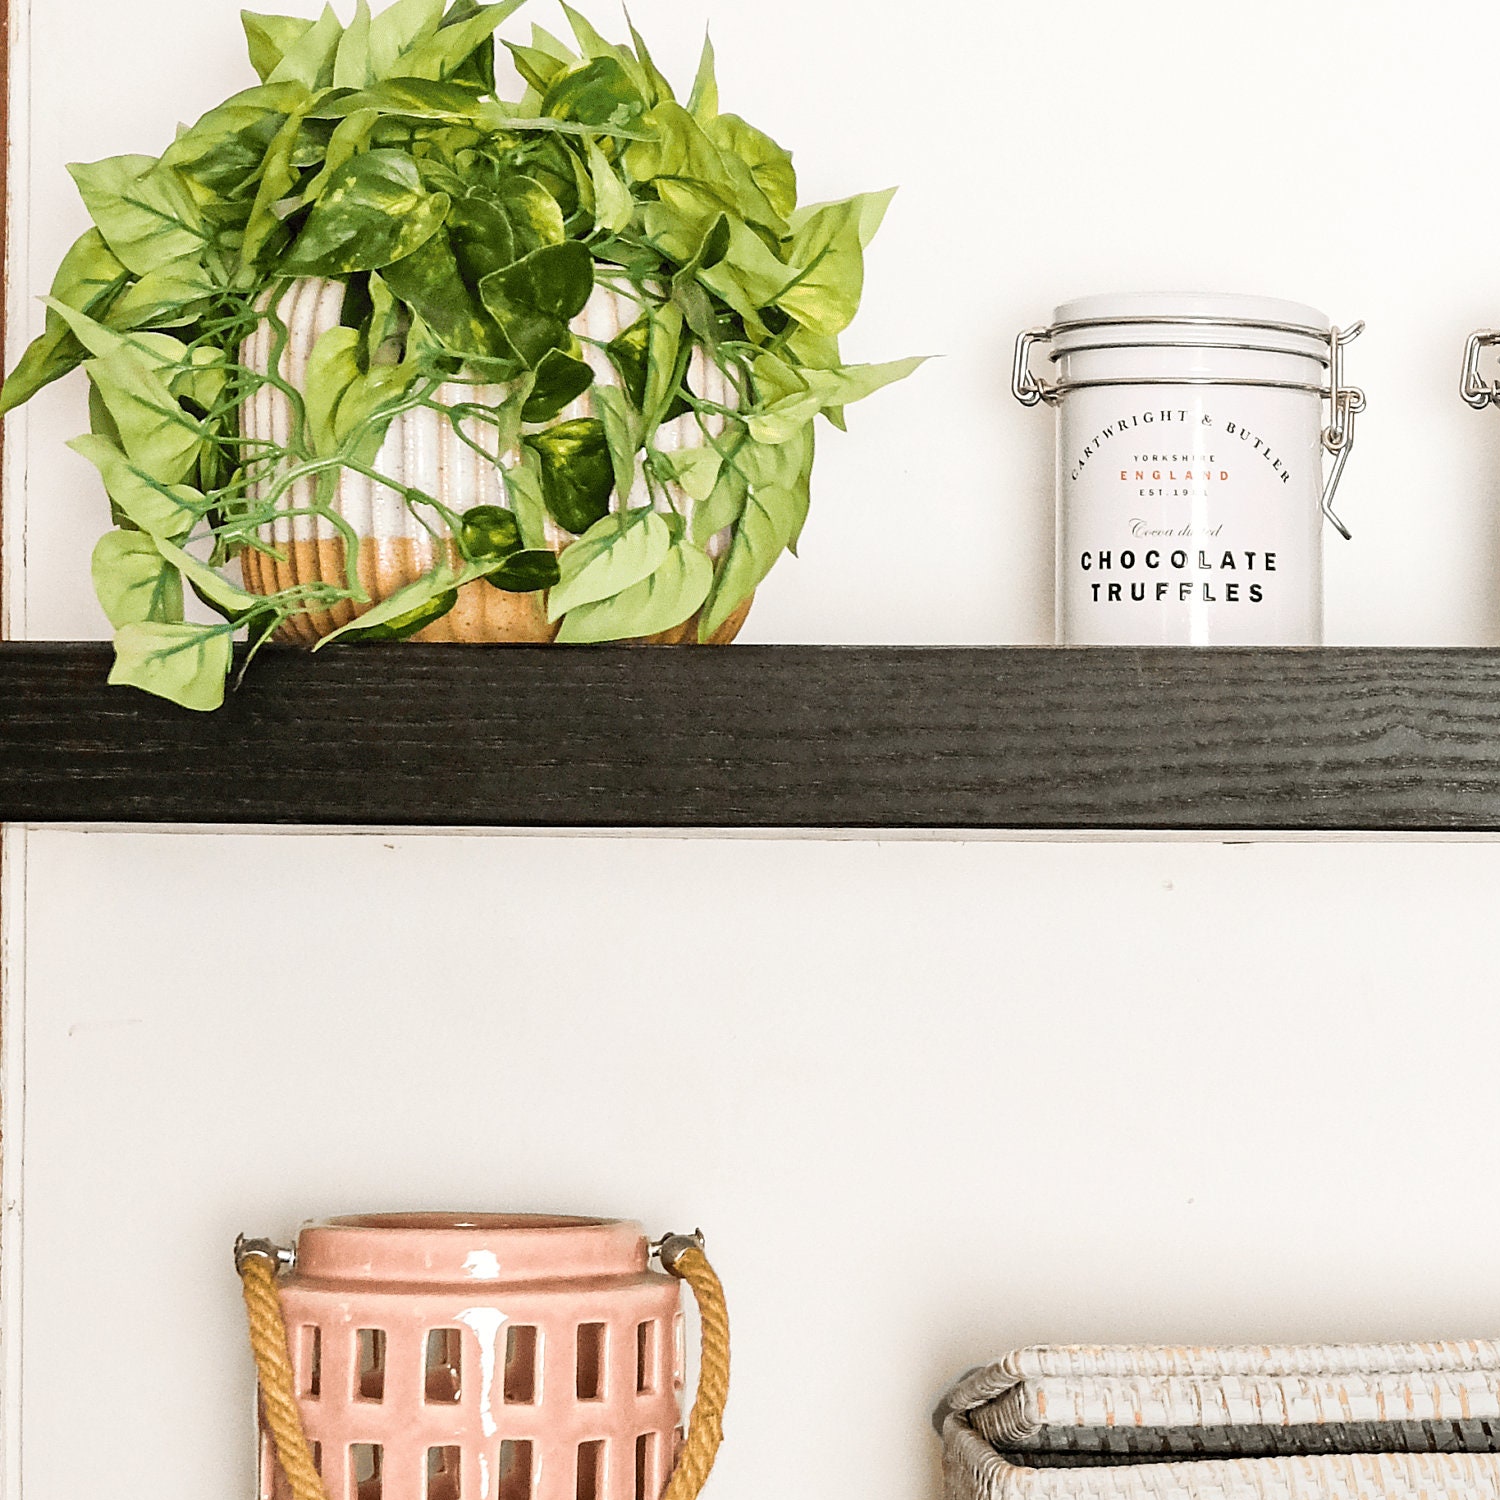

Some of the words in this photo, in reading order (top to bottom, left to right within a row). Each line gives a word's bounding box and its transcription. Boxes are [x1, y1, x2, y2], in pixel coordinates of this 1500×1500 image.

[1072, 410, 1188, 481] CARTWRIGHT
[1202, 414, 1212, 426] &
[1226, 421, 1290, 483] BUTLER
[1120, 470, 1228, 481] ENGLAND
[1081, 549, 1277, 571] CHOCOLATE
[1091, 582, 1263, 602] TRUFFLES
